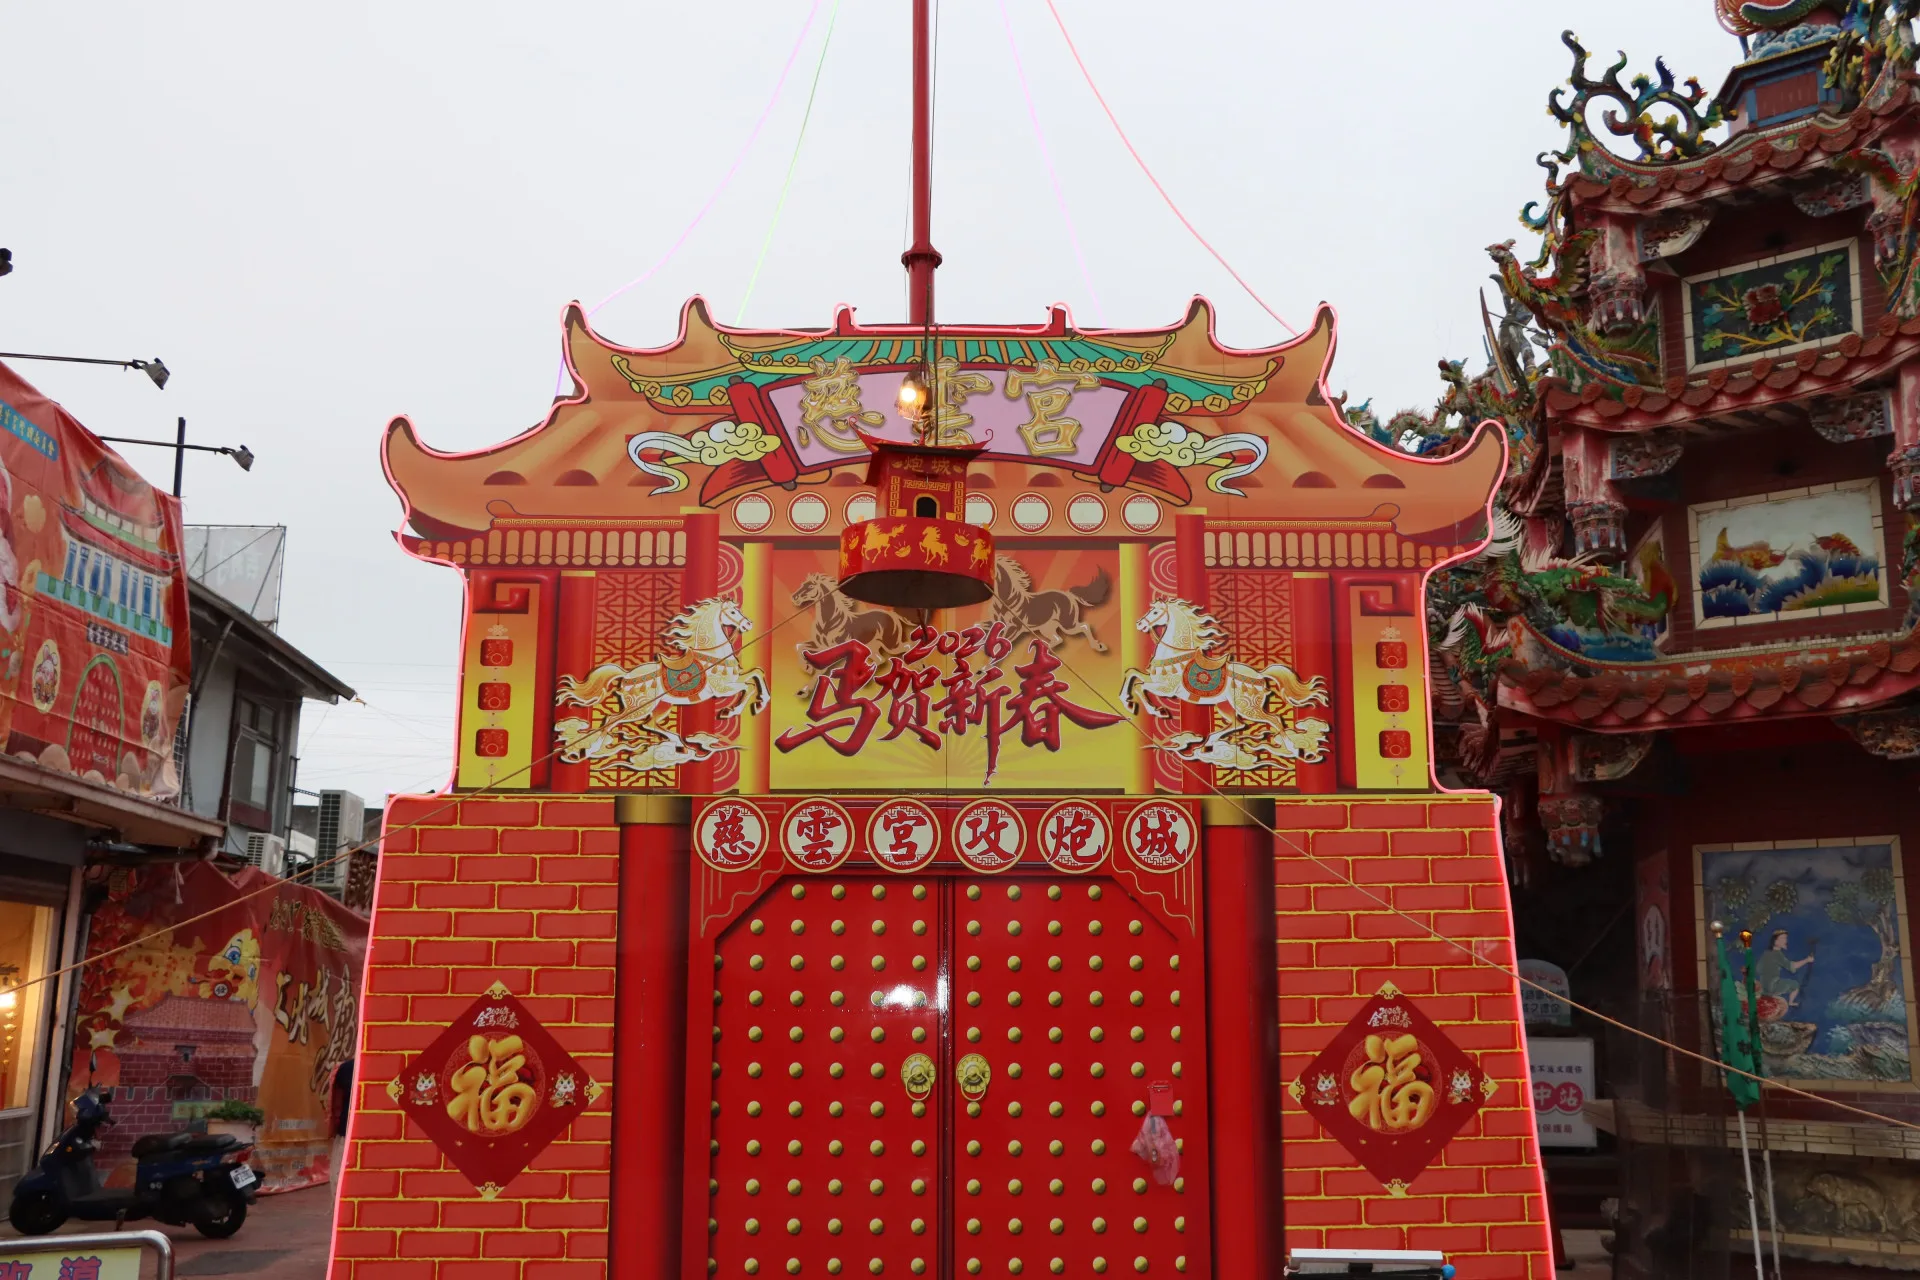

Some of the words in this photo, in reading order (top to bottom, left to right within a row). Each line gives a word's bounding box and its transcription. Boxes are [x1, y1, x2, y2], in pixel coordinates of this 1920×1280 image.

[903, 455, 951, 475] 炮城
[903, 621, 1012, 664] 2026
[774, 639, 1131, 788] 马贺新春
[708, 809, 1189, 865] 慈雲宮攻炮城
[447, 1034, 536, 1131] 福
[1349, 1034, 1434, 1129] 福
